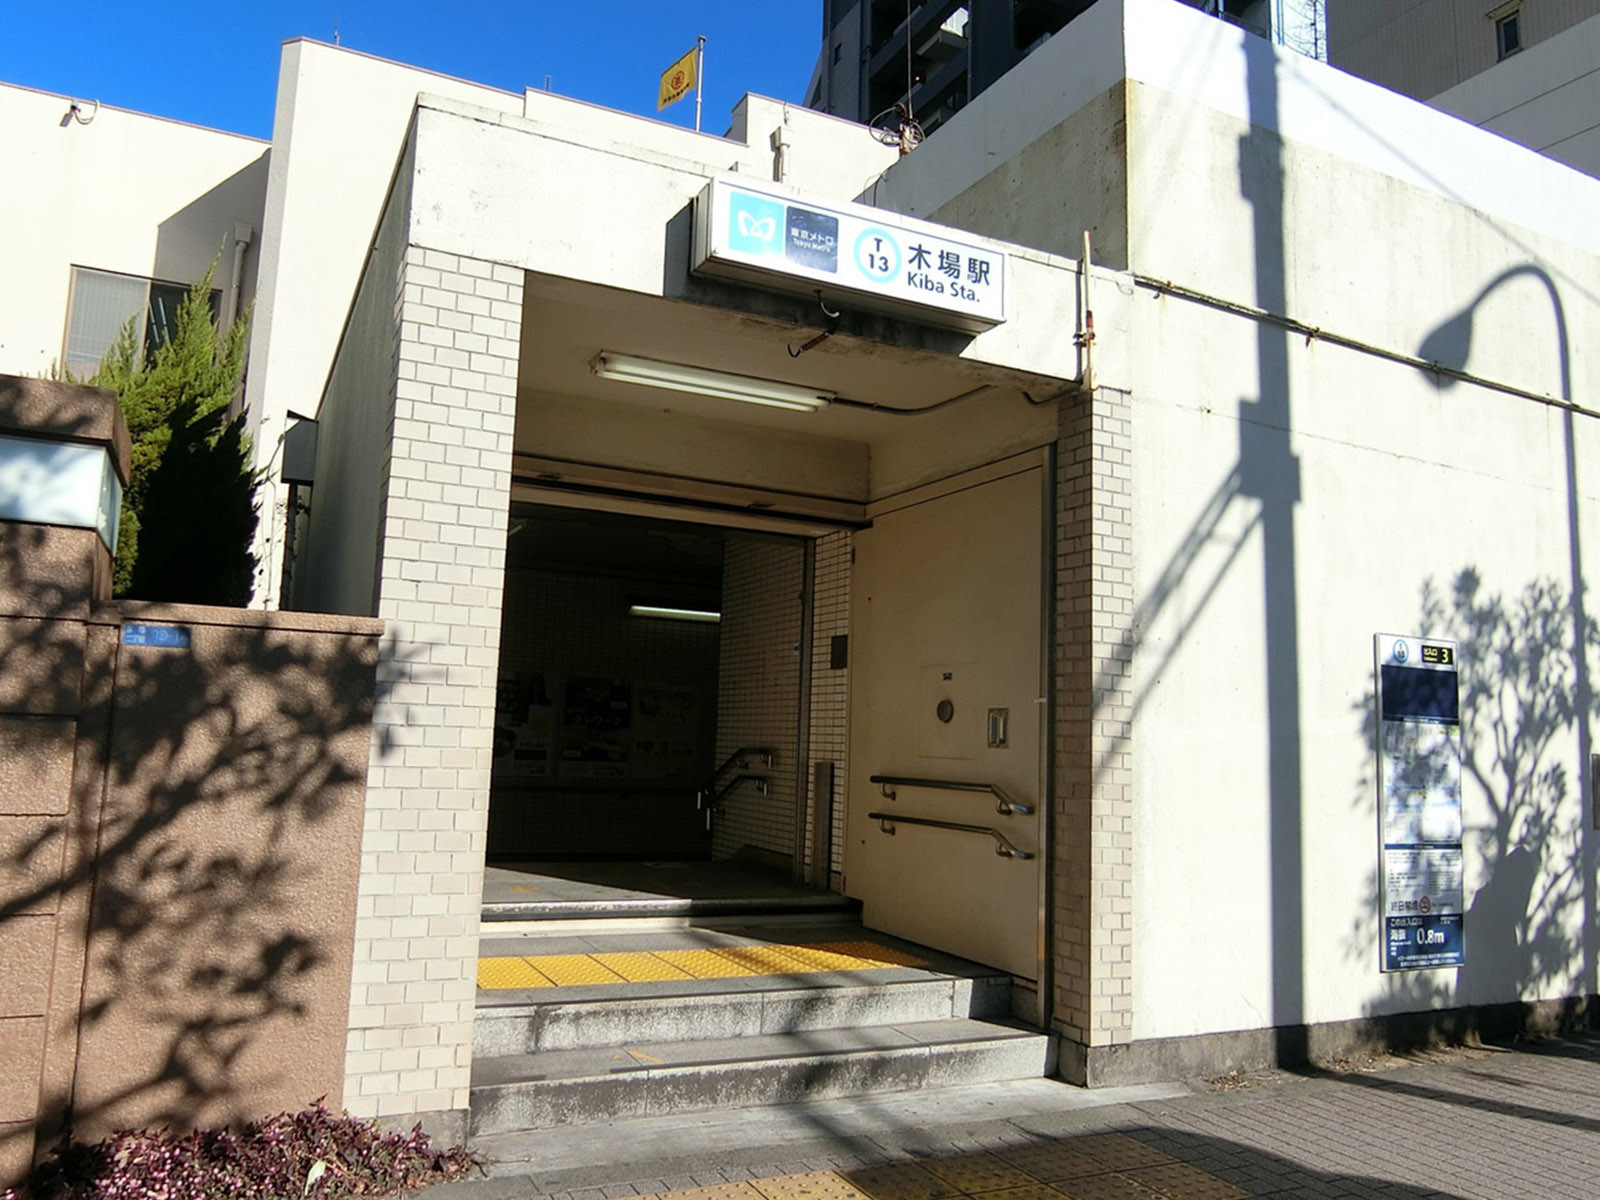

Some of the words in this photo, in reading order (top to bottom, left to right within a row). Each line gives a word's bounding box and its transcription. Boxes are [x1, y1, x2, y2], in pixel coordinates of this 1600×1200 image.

[874, 237, 883, 253] T
[868, 253, 889, 272] 13
[908, 243, 990, 286] 木場駅
[907, 271, 945, 294] Kiba
[950, 281, 980, 302] Sta.
[1441, 648, 1449, 663] 3
[1416, 927, 1445, 945] 0.8m
